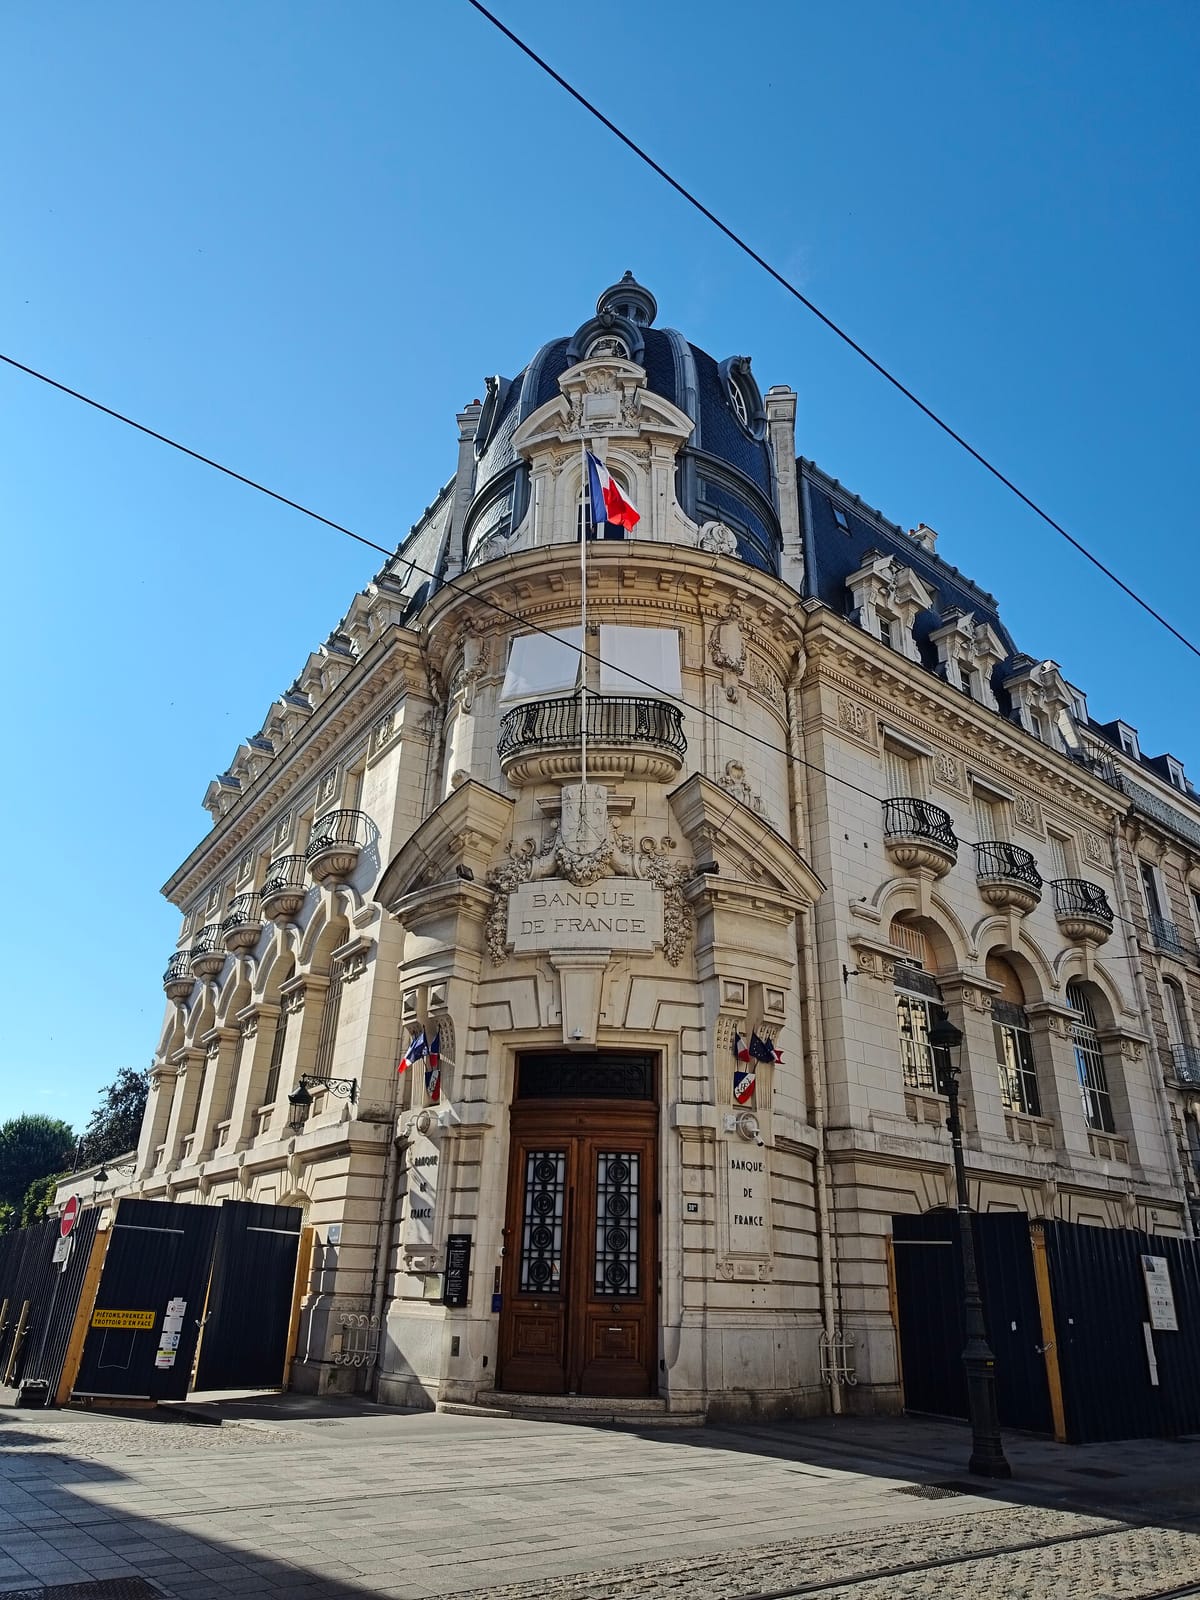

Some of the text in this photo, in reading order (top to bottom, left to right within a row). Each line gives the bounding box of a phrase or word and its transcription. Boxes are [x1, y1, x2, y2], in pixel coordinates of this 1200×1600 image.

[532, 892, 635, 909] BANQUE
[520, 918, 646, 935] DE FRANCE
[731, 1160, 763, 1172] BANQUE
[743, 1188, 753, 1198] DE
[734, 1215, 763, 1226] FRANCE
